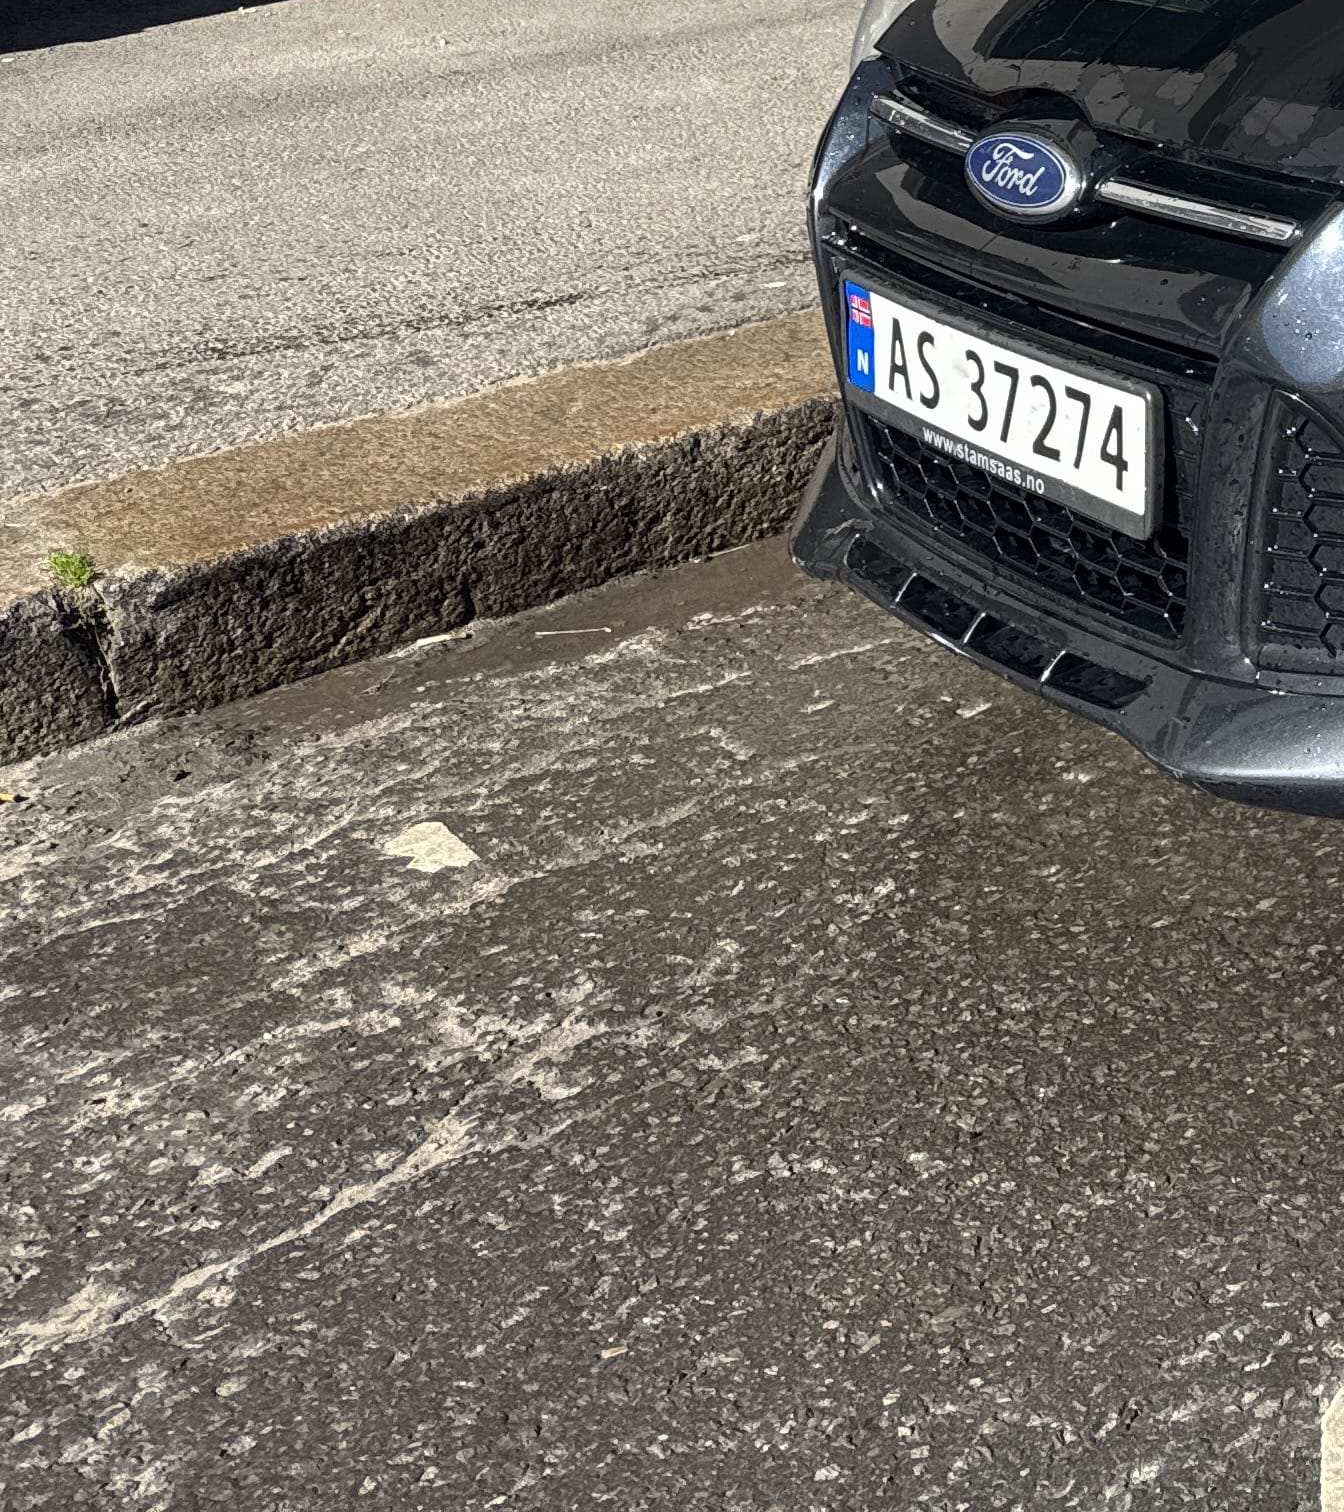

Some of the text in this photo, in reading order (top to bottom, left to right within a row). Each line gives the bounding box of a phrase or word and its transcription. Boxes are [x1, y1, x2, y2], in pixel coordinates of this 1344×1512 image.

[982, 141, 1048, 197] Ford
[857, 348, 869, 376] N
[888, 316, 1129, 492] AS 37274
[922, 426, 1046, 495] www.stamsaas.no
